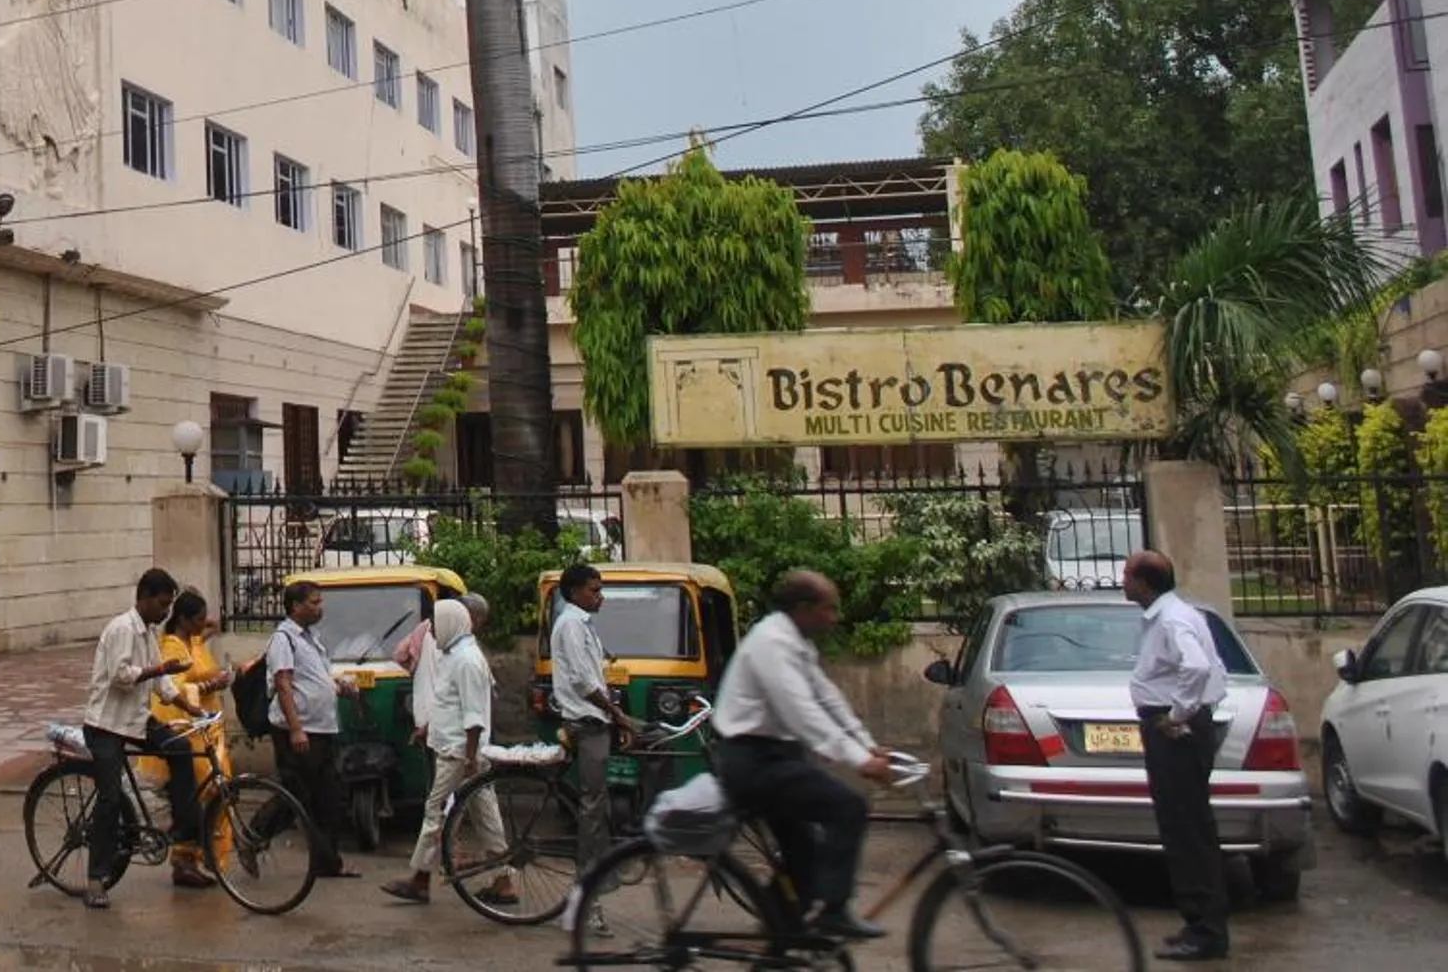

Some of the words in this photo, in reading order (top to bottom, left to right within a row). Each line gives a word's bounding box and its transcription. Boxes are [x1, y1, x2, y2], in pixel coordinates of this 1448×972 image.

[766, 368, 931, 410] Bistro
[936, 362, 1163, 407] Benares
[805, 414, 871, 435] MULTI
[879, 411, 956, 433] CUISINE
[967, 407, 1108, 431] RESTAURANT
